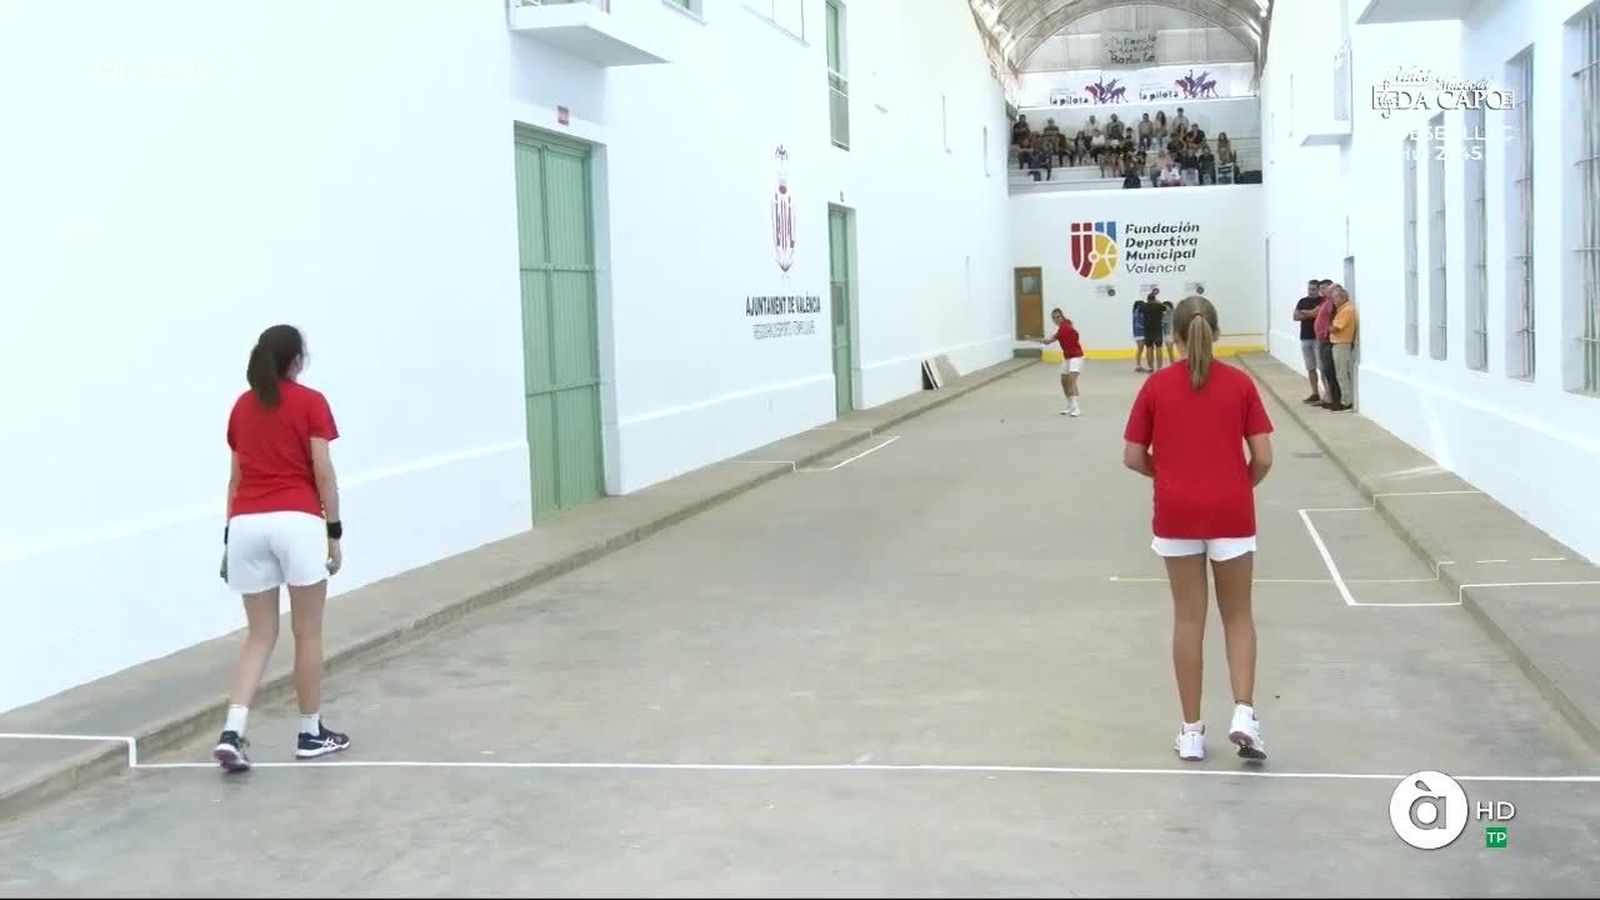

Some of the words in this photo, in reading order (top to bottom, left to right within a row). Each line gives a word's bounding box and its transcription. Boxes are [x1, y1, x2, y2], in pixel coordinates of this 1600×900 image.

[1049, 95, 1057, 105] la
[1059, 95, 1088, 106] pilota
[1139, 91, 1147, 100] la
[1149, 89, 1178, 101] pilota
[1125, 222, 1200, 234] Fundación
[1125, 236, 1198, 249] Deportiva
[1125, 248, 1197, 261] Municipal
[1125, 262, 1187, 274] Valencia
[745, 296, 786, 316] AJUNTAMENT
[788, 295, 795, 314] DE
[796, 291, 821, 313] VALÈNCIA
